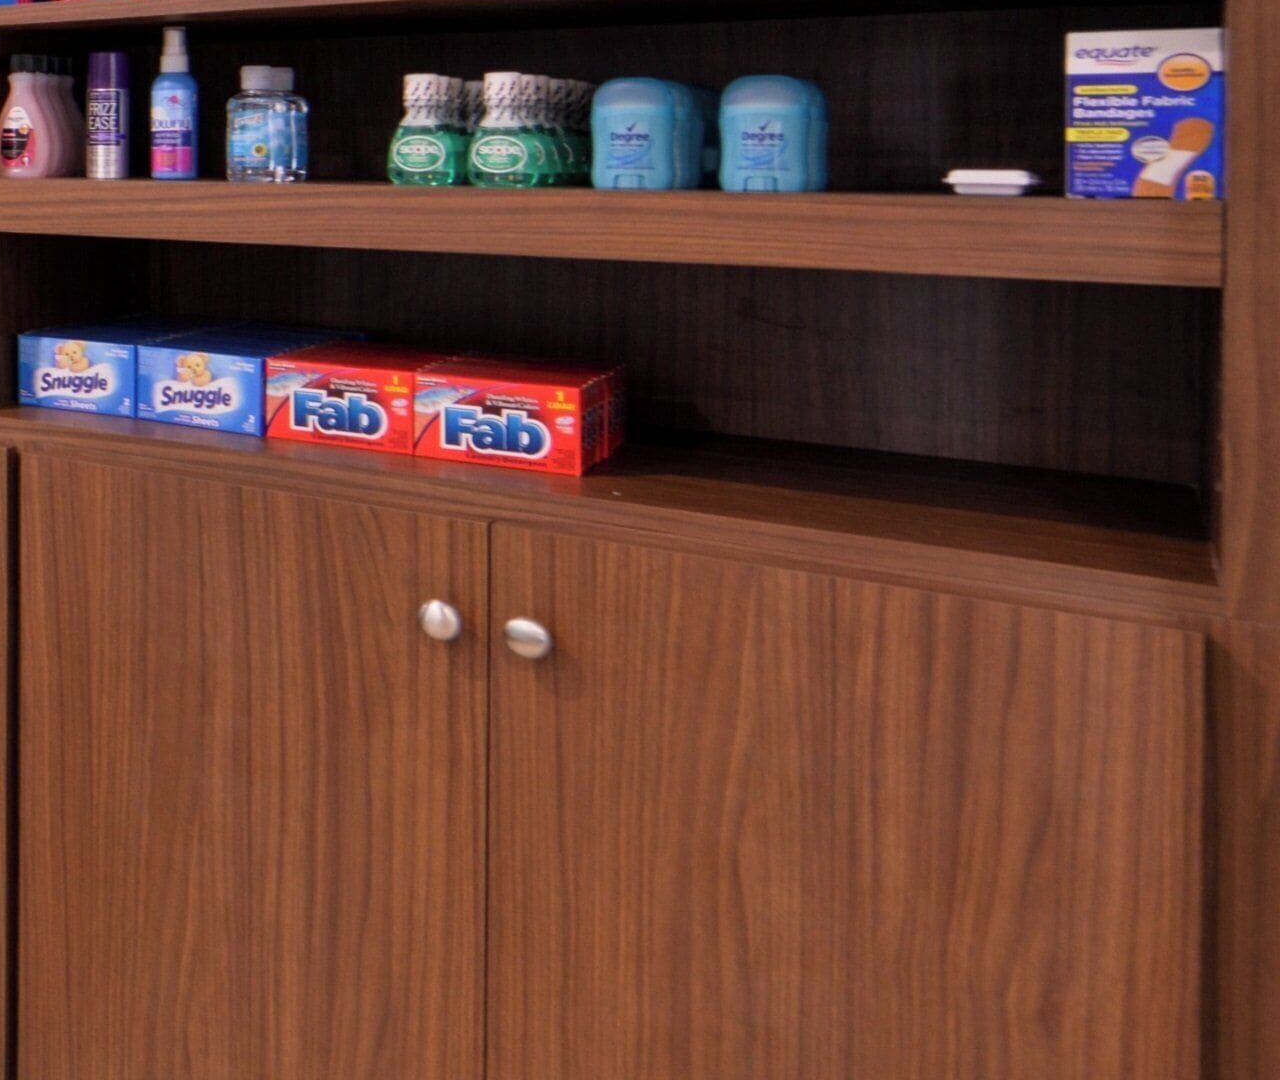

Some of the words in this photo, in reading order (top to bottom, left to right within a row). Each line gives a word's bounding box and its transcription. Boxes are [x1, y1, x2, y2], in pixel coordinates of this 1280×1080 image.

[1074, 46, 1156, 64] equate
[1072, 96, 1139, 107] Flexible
[1141, 95, 1197, 107] Fabric
[88, 103, 118, 116] FRIZZ
[1072, 108, 1157, 121] Bandages
[88, 117, 118, 130] EASE
[609, 130, 650, 144] Degree
[741, 130, 784, 144] Degree
[40, 372, 109, 394] Snuggle
[160, 385, 232, 410] Snuggle
[290, 387, 389, 440] Fab
[440, 403, 552, 460] Fab
